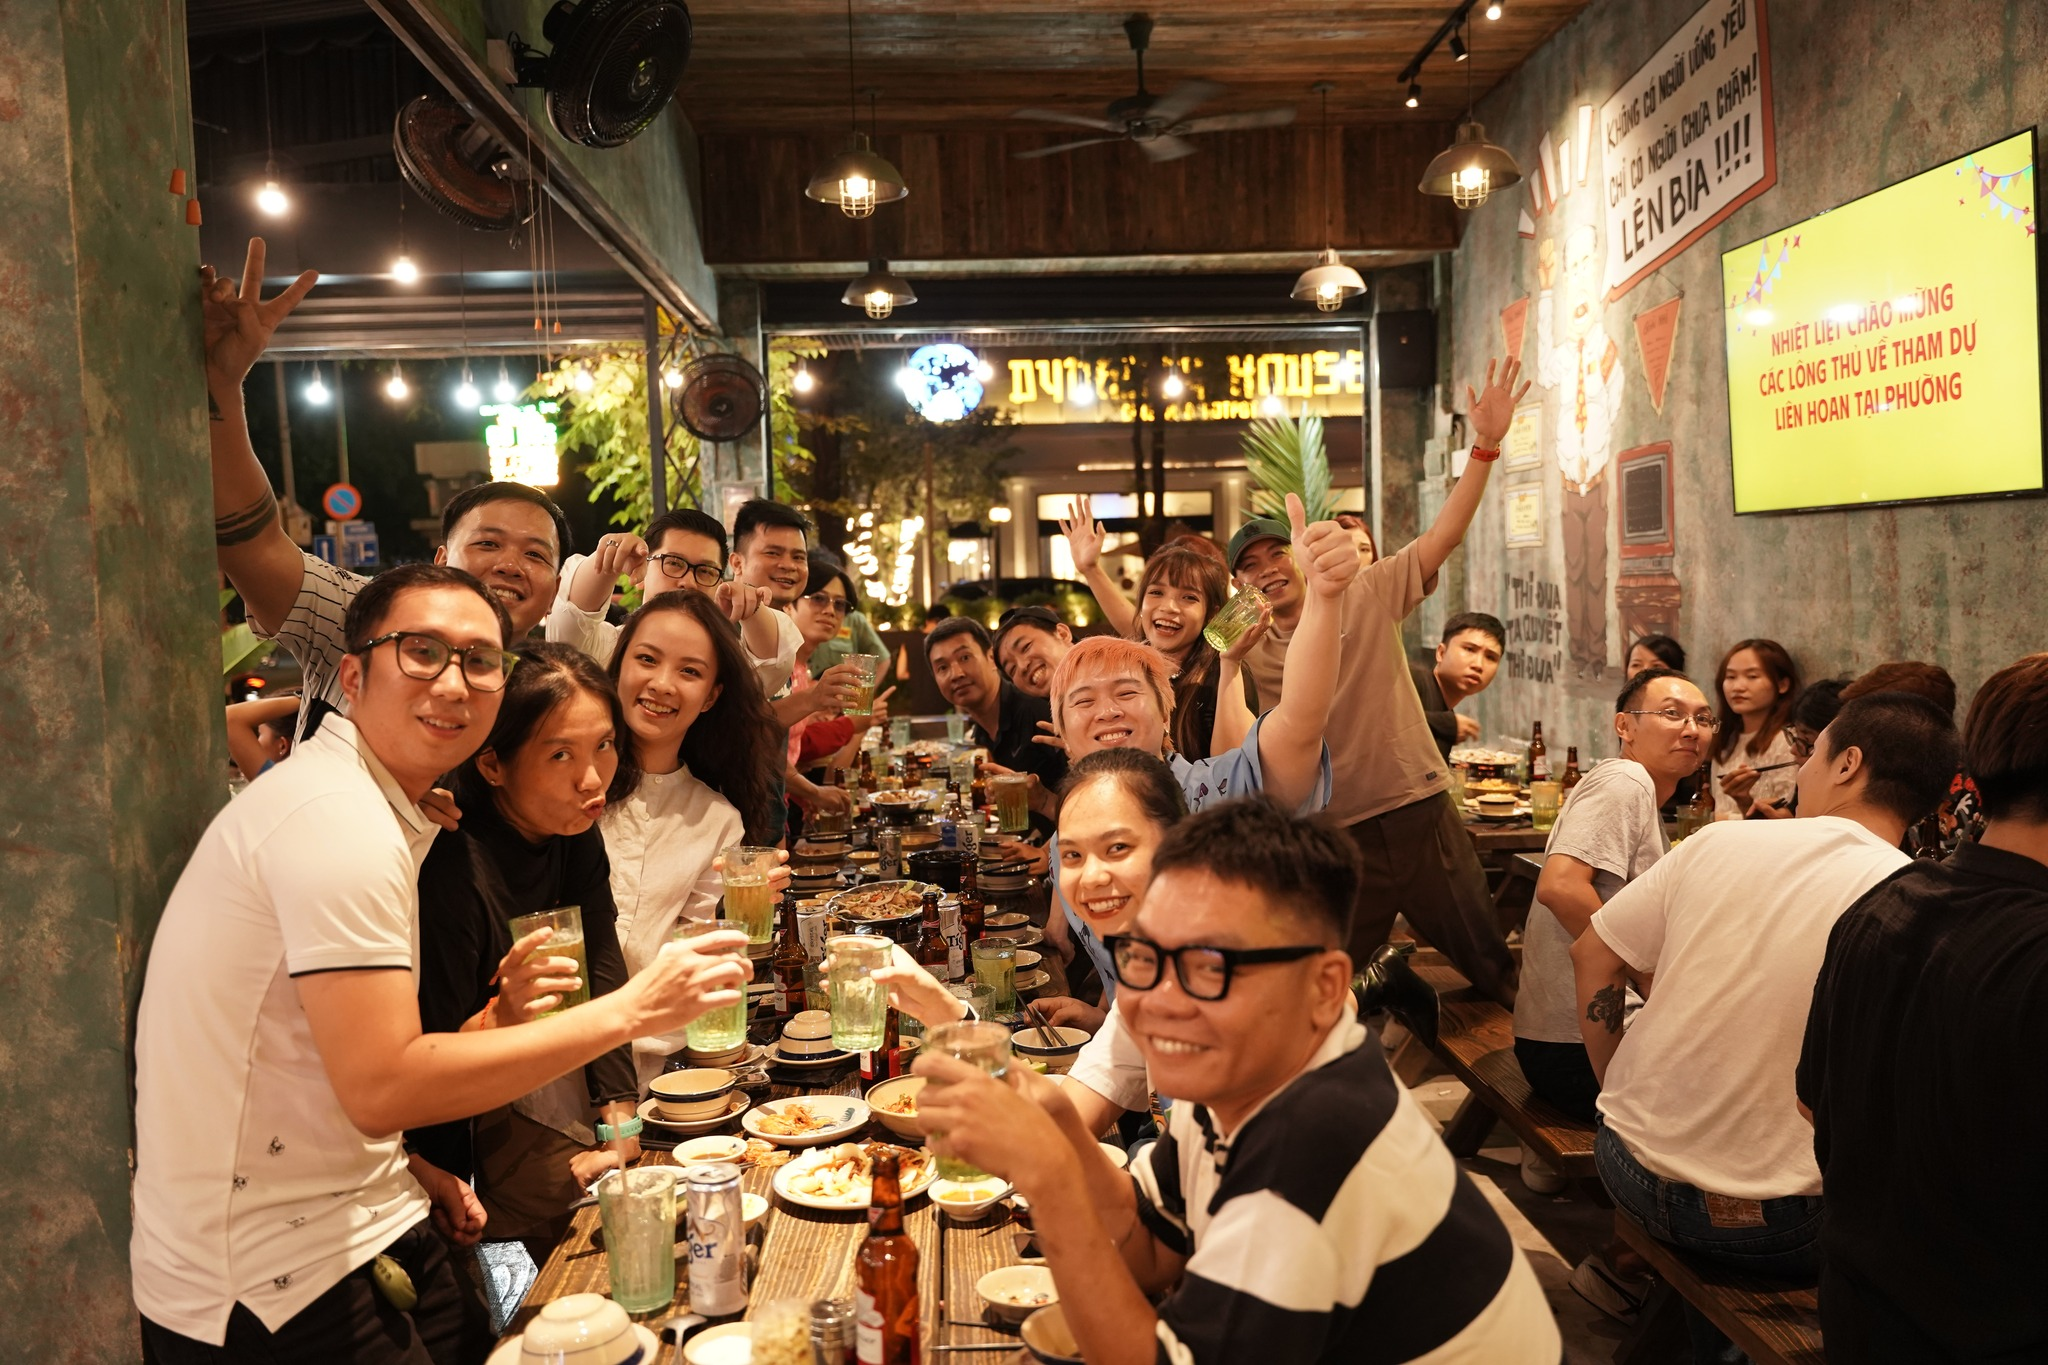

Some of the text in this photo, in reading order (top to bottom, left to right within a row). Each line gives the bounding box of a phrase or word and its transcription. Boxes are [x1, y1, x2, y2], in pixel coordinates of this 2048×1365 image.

[1606, 98, 1640, 153] KHÔNG
[1643, 76, 1656, 119] CÓ
[1659, 52, 1686, 104] NGƯỜI
[1688, 25, 1716, 77] UỐNG
[1630, 147, 1643, 190] CÓ
[1647, 124, 1677, 175] NGƯỜI
[1681, 100, 1711, 148] CHƯA
[1622, 185, 1664, 263] LÊN
[1759, 319, 1977, 397] CÁC LÔNG THỦ VỀ THAM DỰ
[1771, 321, 1810, 357] NHIỆT
[1775, 372, 1963, 431] LIÊN HOAN TẠI PHƯỜNG
